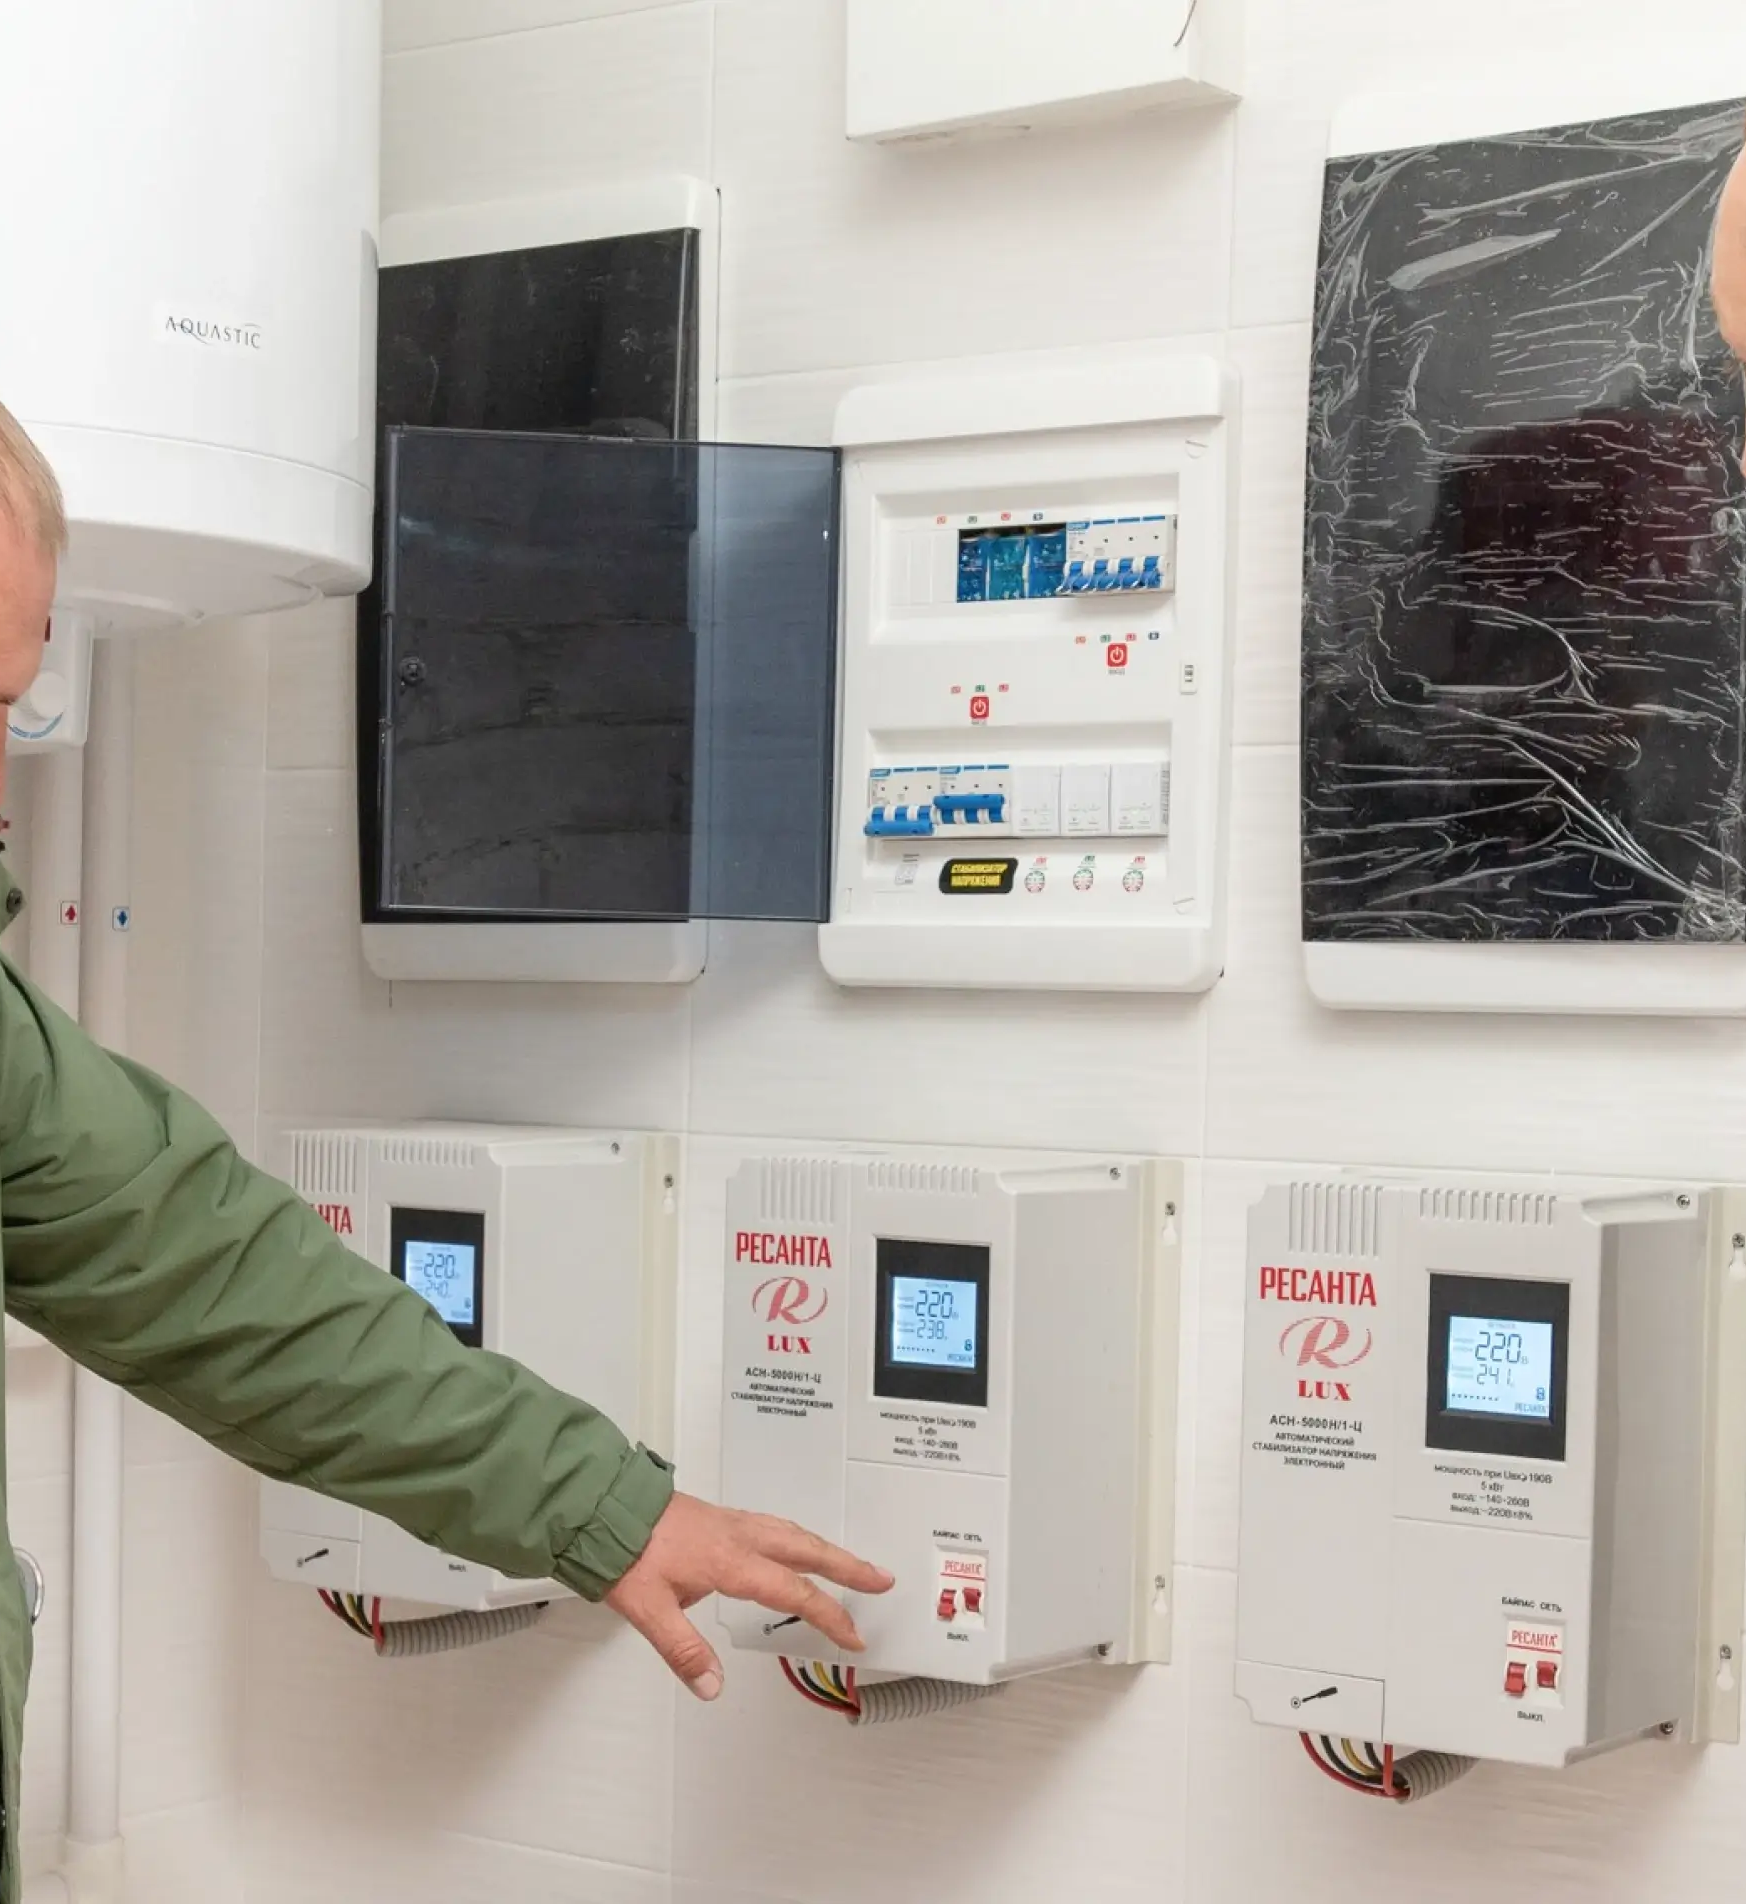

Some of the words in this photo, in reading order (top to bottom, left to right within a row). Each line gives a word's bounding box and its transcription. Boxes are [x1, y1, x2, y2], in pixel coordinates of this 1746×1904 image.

[165, 315, 261, 349] AQUASTIC
[736, 1231, 832, 1268] РЕСАНТА
[424, 1252, 457, 1279] 220
[1259, 1266, 1377, 1307] РЕСАНТА
[915, 1290, 954, 1319] 220
[917, 1319, 945, 1339] 238
[767, 1334, 812, 1354] LUX
[1475, 1331, 1522, 1364] 220
[1476, 1363, 1511, 1385] 241
[1297, 1379, 1352, 1402] LUX
[1539, 1601, 1562, 1613] СЕТЬ
[1510, 1630, 1557, 1647] РЕСАНТА
